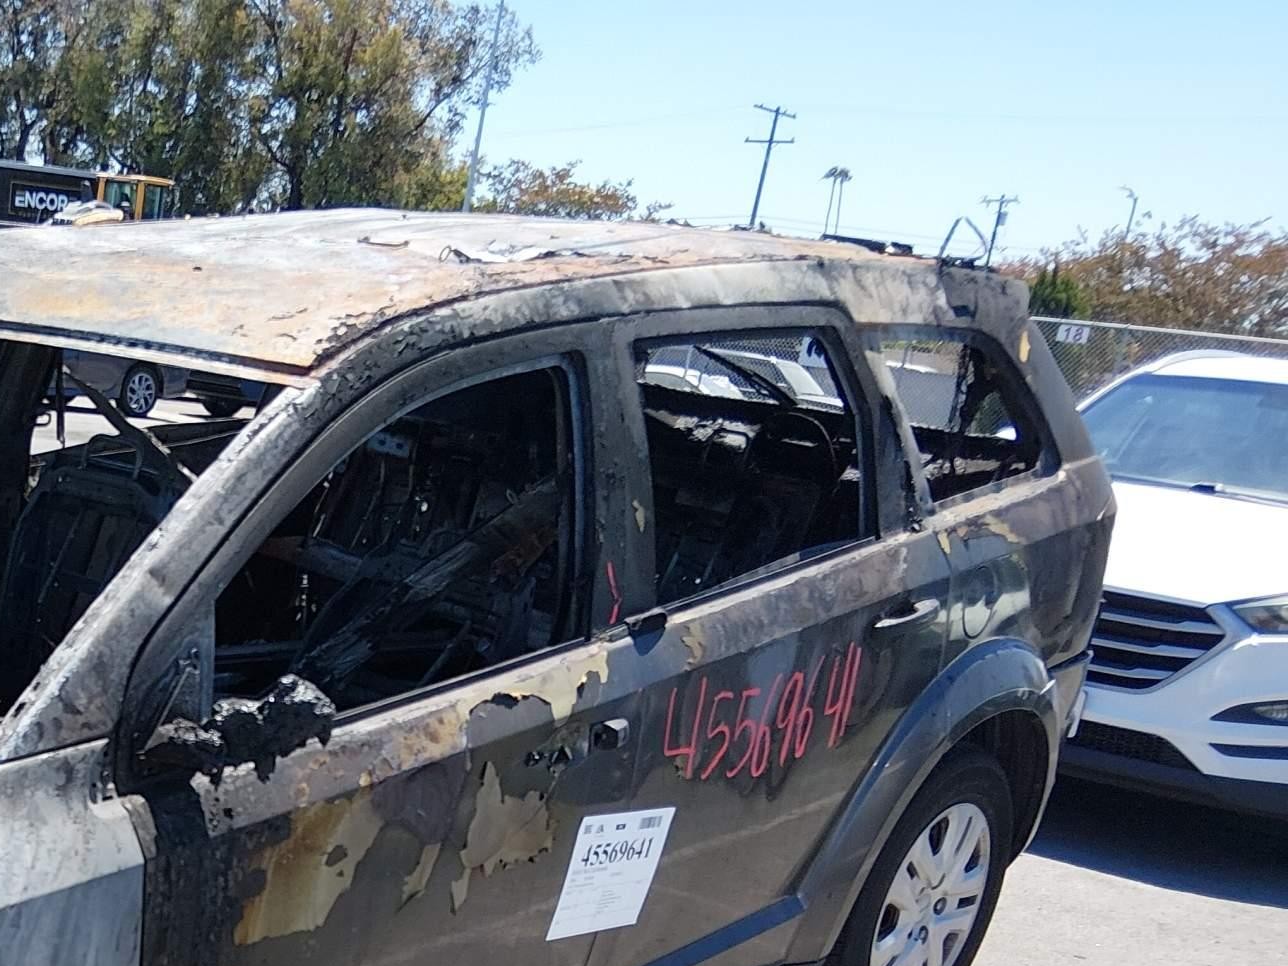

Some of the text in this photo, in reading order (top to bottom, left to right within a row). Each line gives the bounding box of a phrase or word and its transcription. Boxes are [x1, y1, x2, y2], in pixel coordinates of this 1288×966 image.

[15, 190, 77, 212] ENCOR
[1063, 326, 1085, 343] 18
[663, 641, 862, 781] 45569641
[581, 837, 655, 867] 45569641
